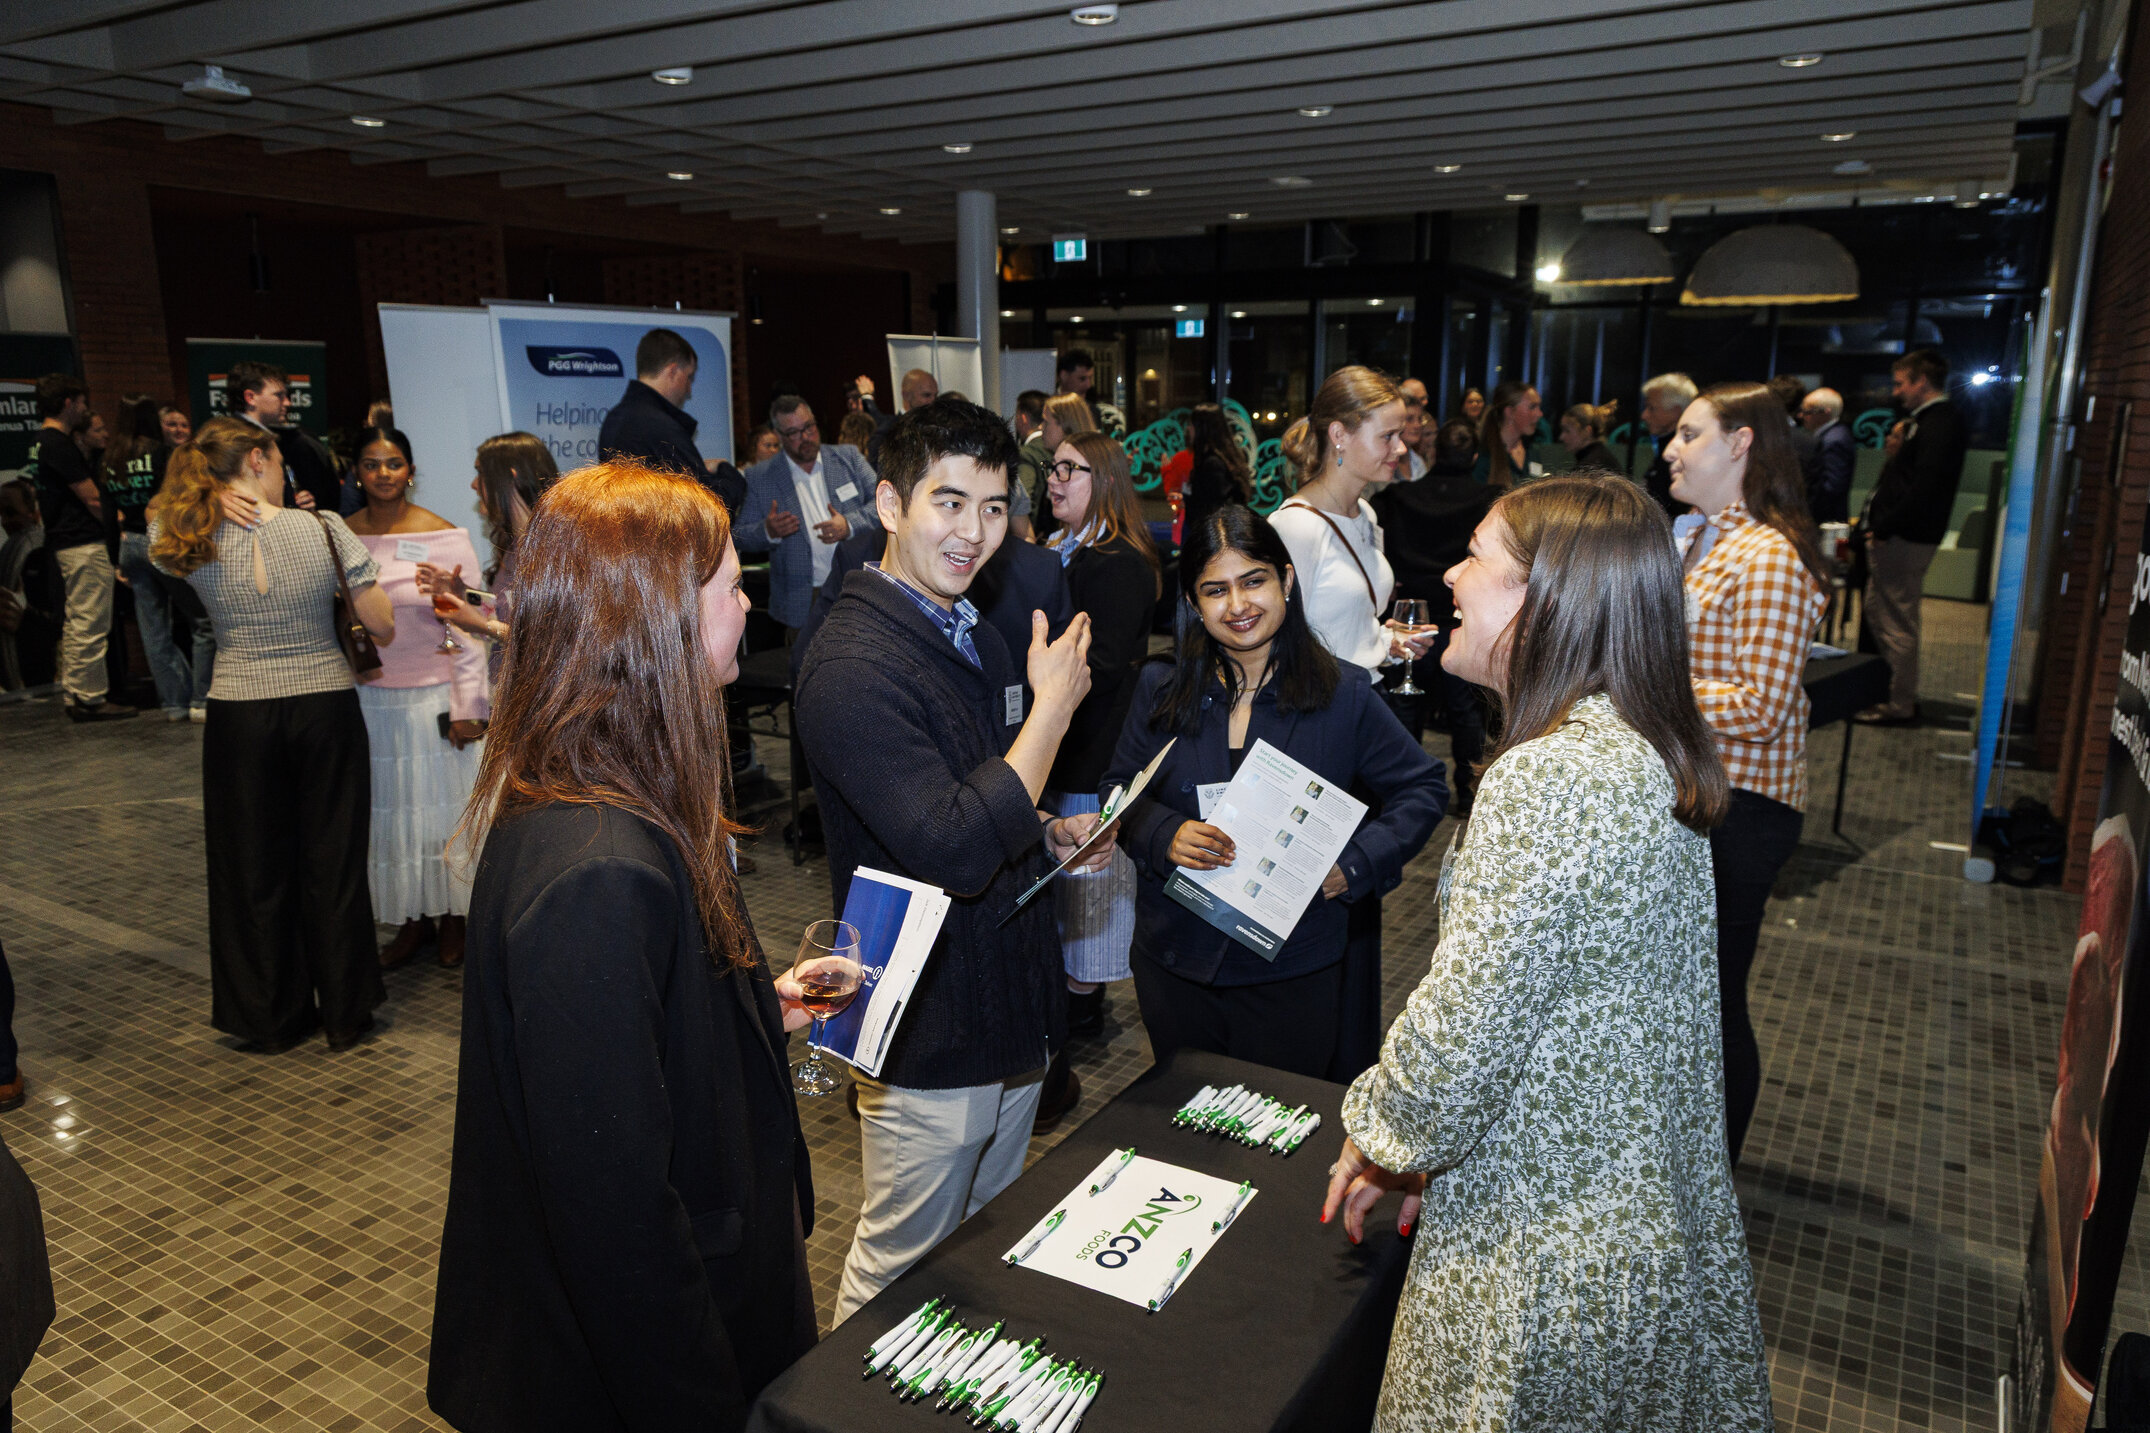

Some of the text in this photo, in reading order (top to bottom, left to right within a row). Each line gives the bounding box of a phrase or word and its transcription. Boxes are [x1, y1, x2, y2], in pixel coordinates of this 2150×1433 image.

[548, 360, 619, 373] PGG Wrightson
[576, 439, 600, 458] co
[1095, 1186, 1183, 1269] ANZCO
[1075, 1229, 1112, 1261] FOODS
